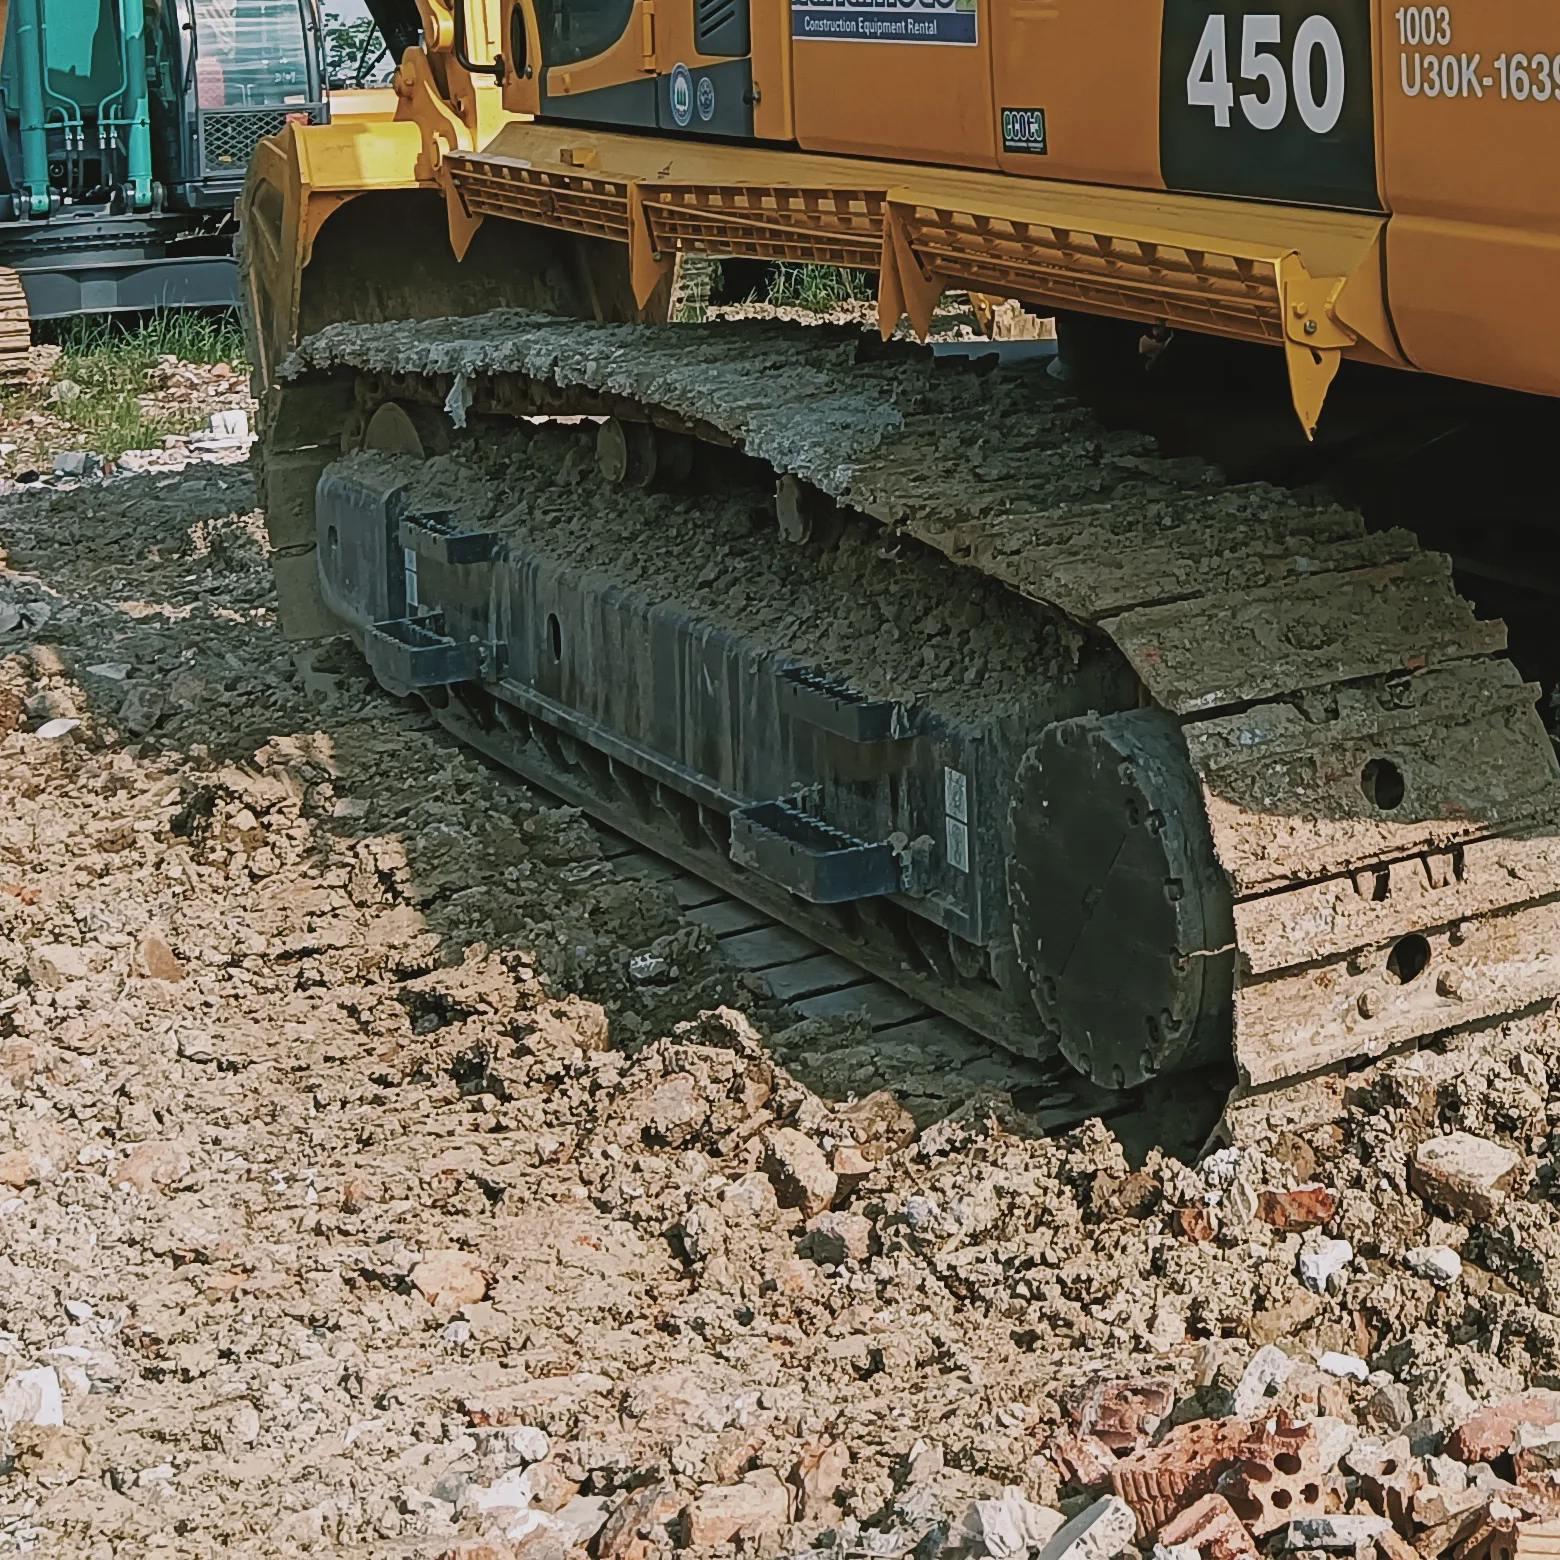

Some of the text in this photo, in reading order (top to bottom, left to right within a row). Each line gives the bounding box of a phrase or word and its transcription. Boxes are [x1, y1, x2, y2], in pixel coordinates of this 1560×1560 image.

[804, 15, 937, 36] Construction Equipment Rental
[1395, 6, 1451, 45] 1003
[1186, 14, 1345, 134] 450
